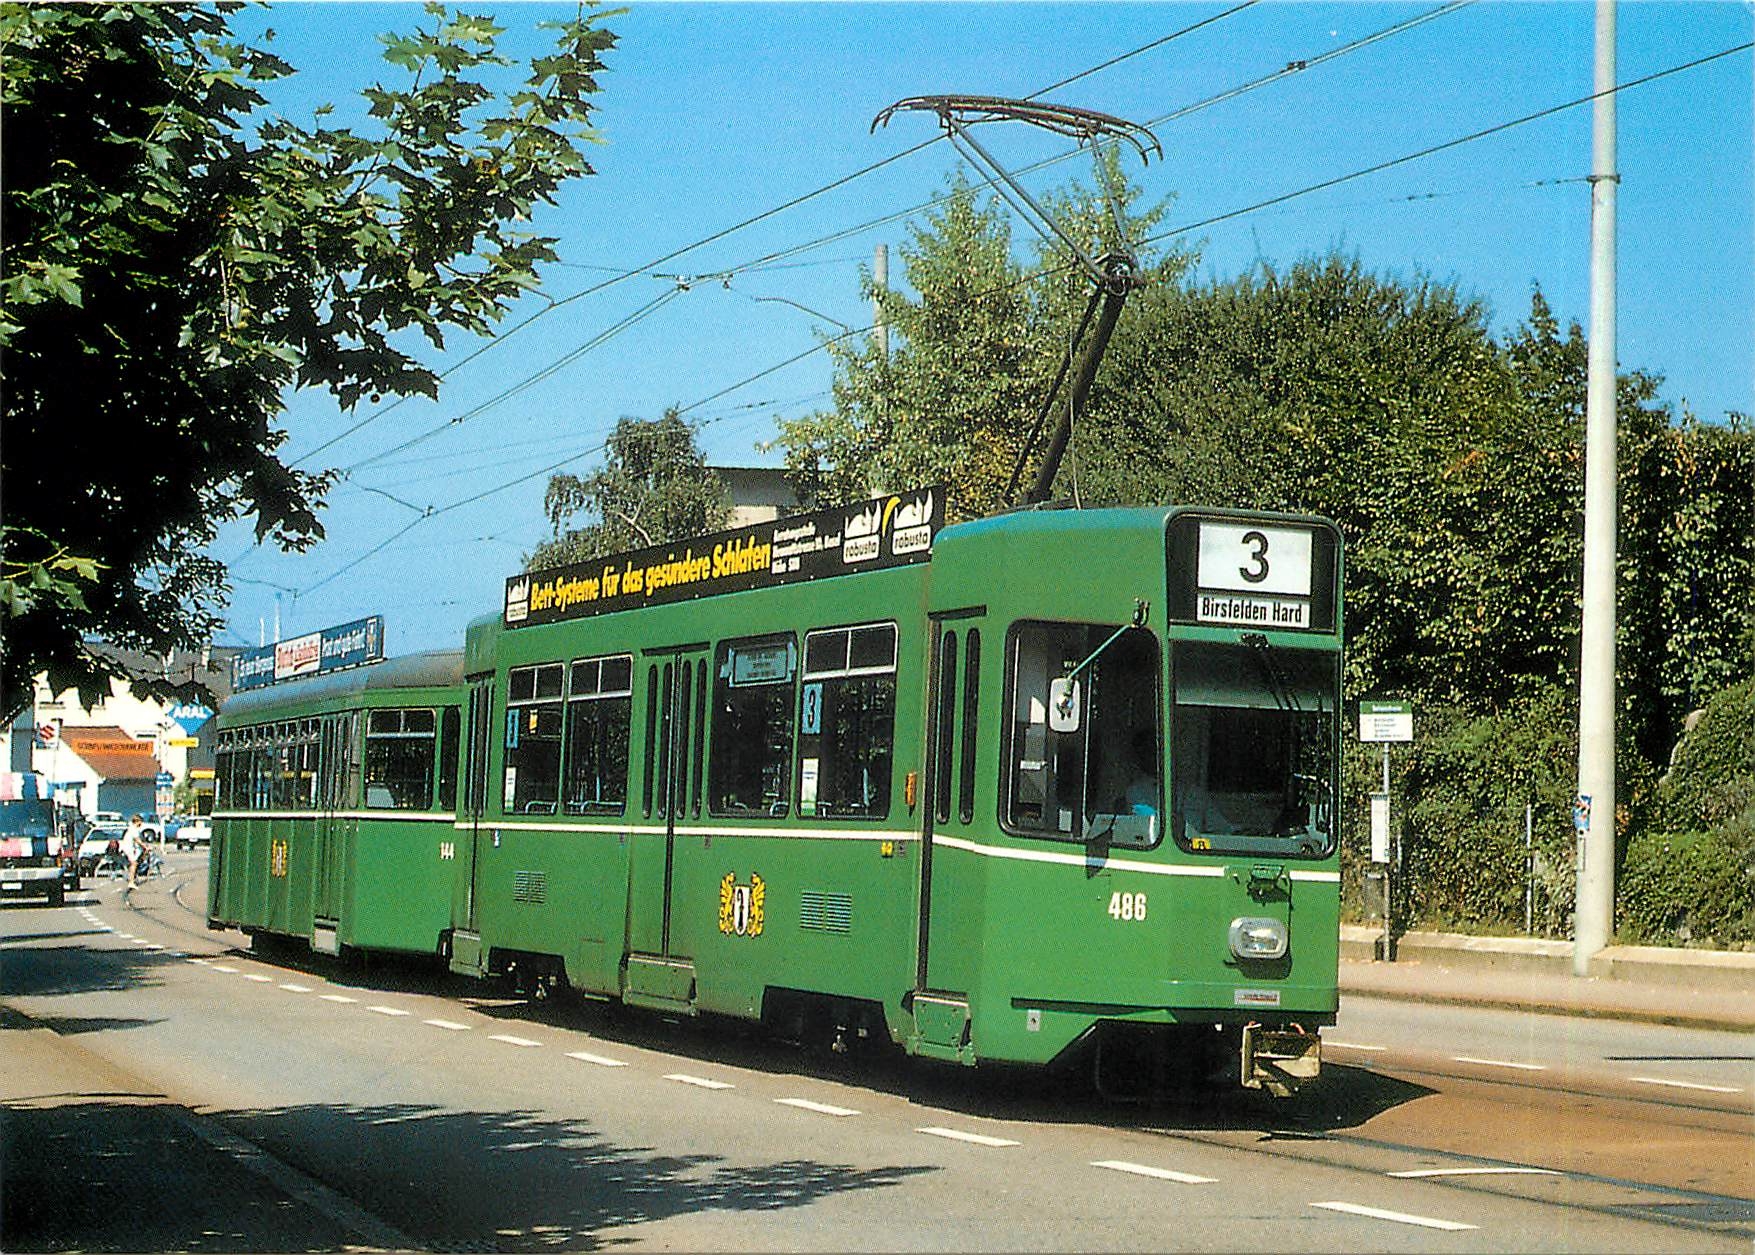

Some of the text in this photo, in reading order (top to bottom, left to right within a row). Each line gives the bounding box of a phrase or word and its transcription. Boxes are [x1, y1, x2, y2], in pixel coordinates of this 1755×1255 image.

[845, 541, 877, 558] robusta
[895, 531, 928, 549] robusta
[1239, 531, 1269, 583] 3
[530, 576, 600, 612] Bett-Systeme
[601, 565, 620, 598] für
[622, 561, 644, 594] das
[645, 548, 711, 597] gesündere
[711, 535, 771, 578] Schlafen
[1202, 597, 1302, 623] Birsfelden Hard
[172, 705, 208, 719] ARAL
[807, 689, 816, 728] 3
[1108, 891, 1147, 921] 486
